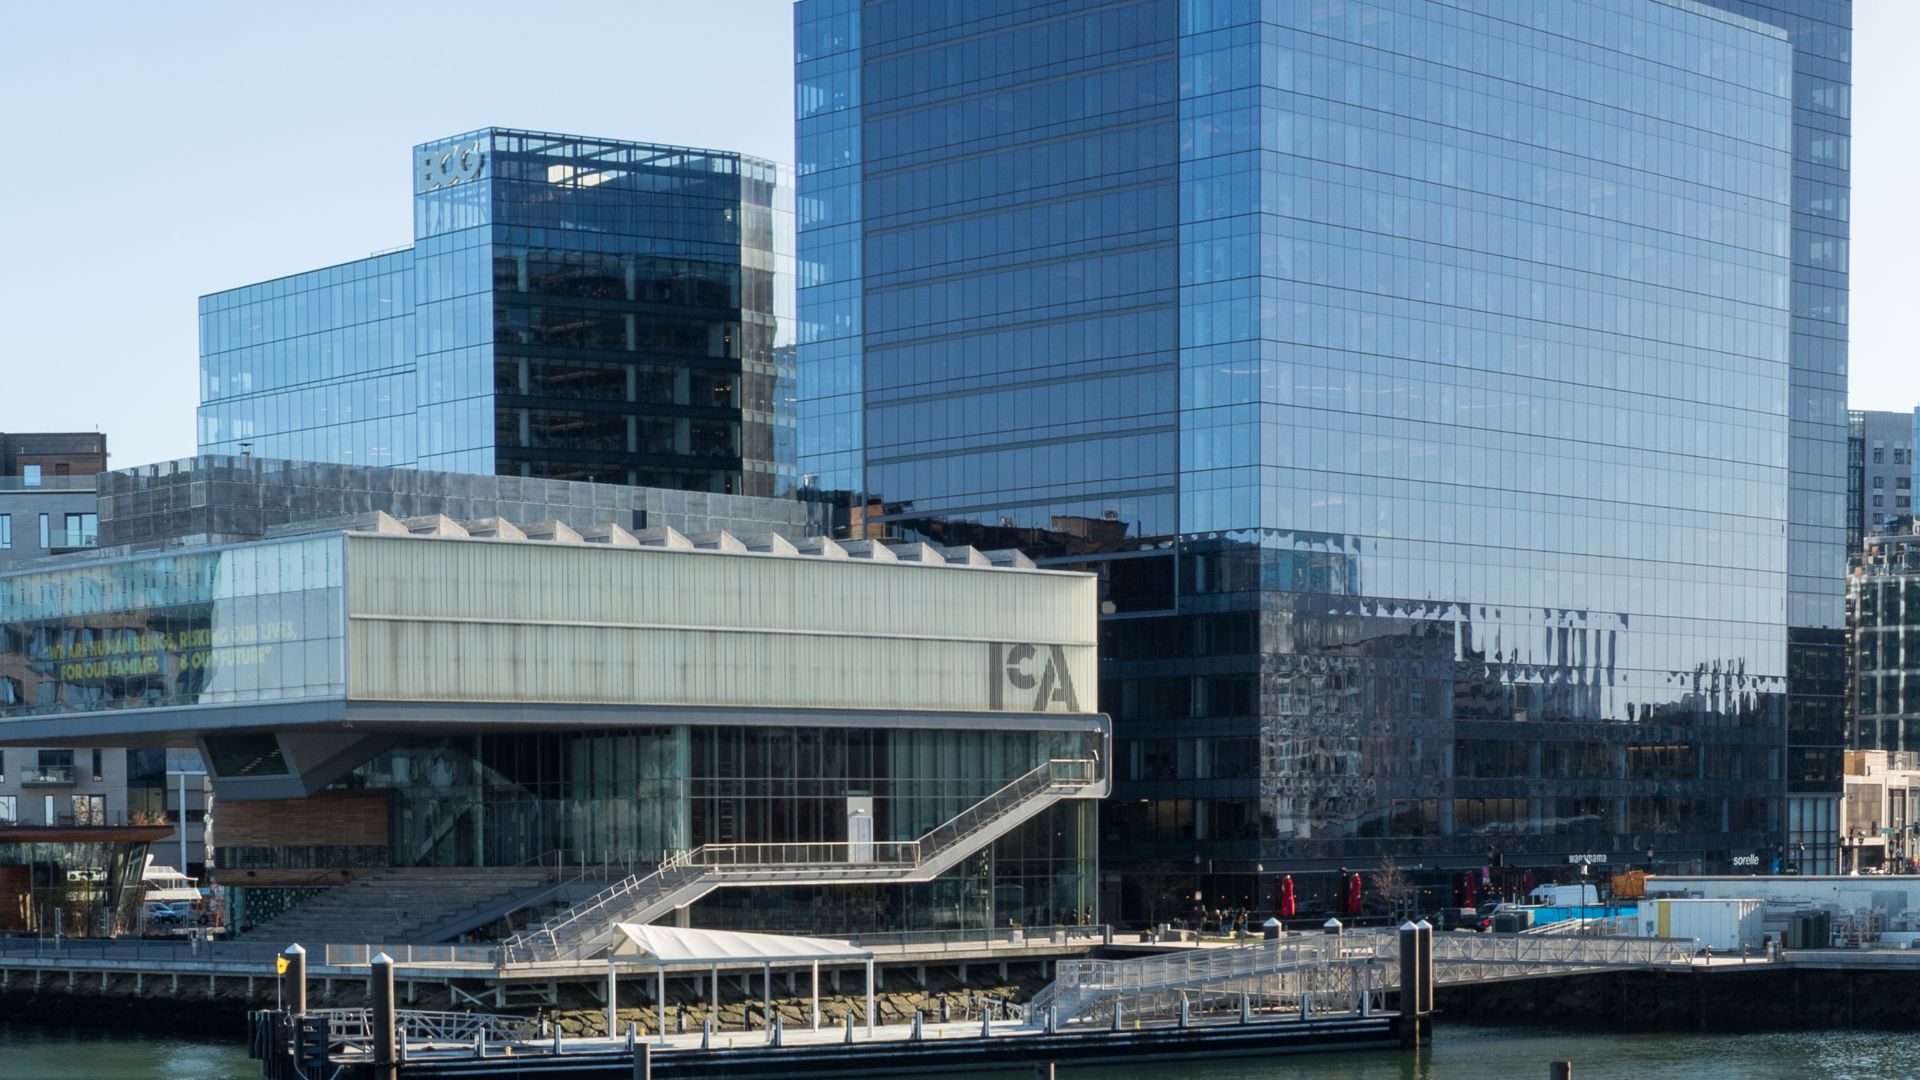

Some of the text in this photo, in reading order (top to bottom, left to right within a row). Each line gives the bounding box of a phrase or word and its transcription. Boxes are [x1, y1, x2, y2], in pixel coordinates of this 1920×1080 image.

[419, 139, 483, 192] BCG
[61, 664, 83, 680] FOR
[85, 661, 108, 678] OUR
[111, 656, 159, 675] FAMILIES
[180, 653, 189, 670] &
[989, 642, 1081, 712] ICA
[1733, 854, 1759, 866] sorelle
